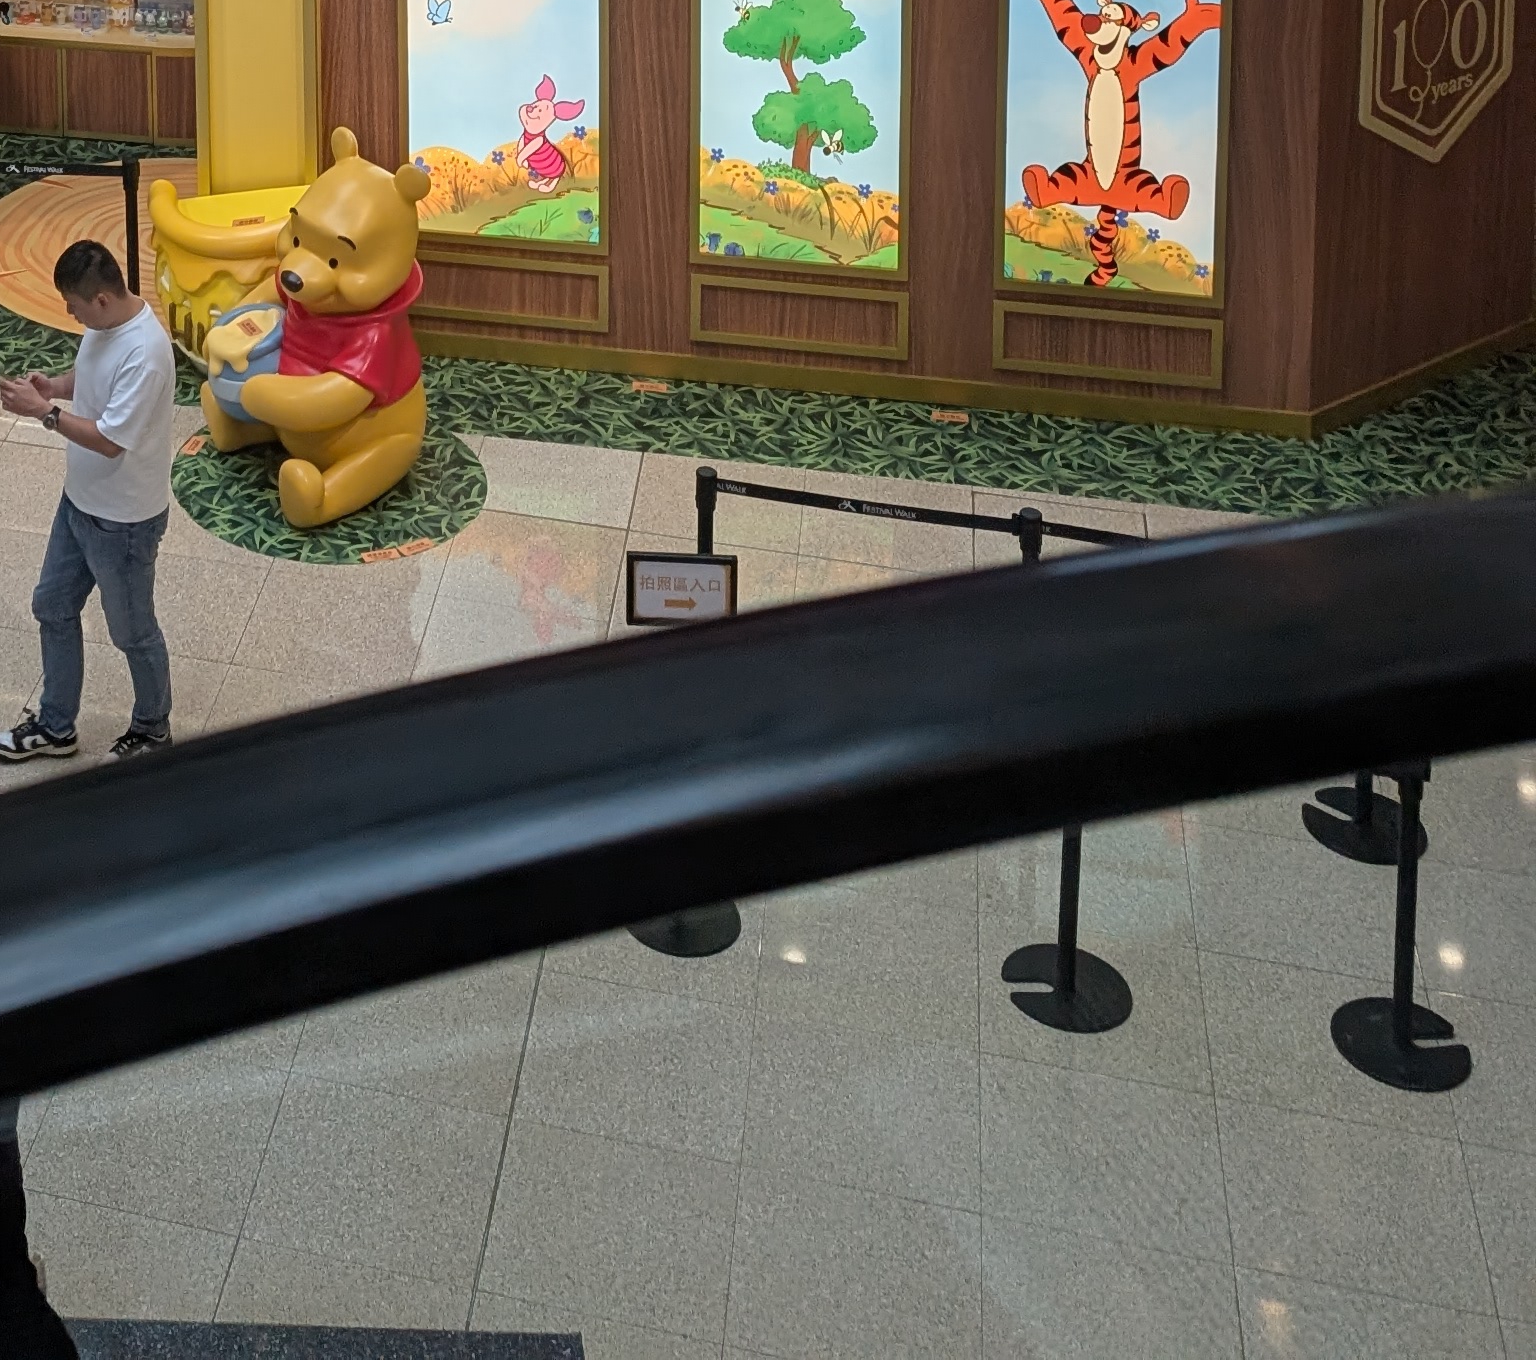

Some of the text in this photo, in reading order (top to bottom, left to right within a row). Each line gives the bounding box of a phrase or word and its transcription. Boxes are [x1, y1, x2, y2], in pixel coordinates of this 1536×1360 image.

[1431, 72, 1475, 105] years
[639, 573, 722, 593] 拍照區入口
